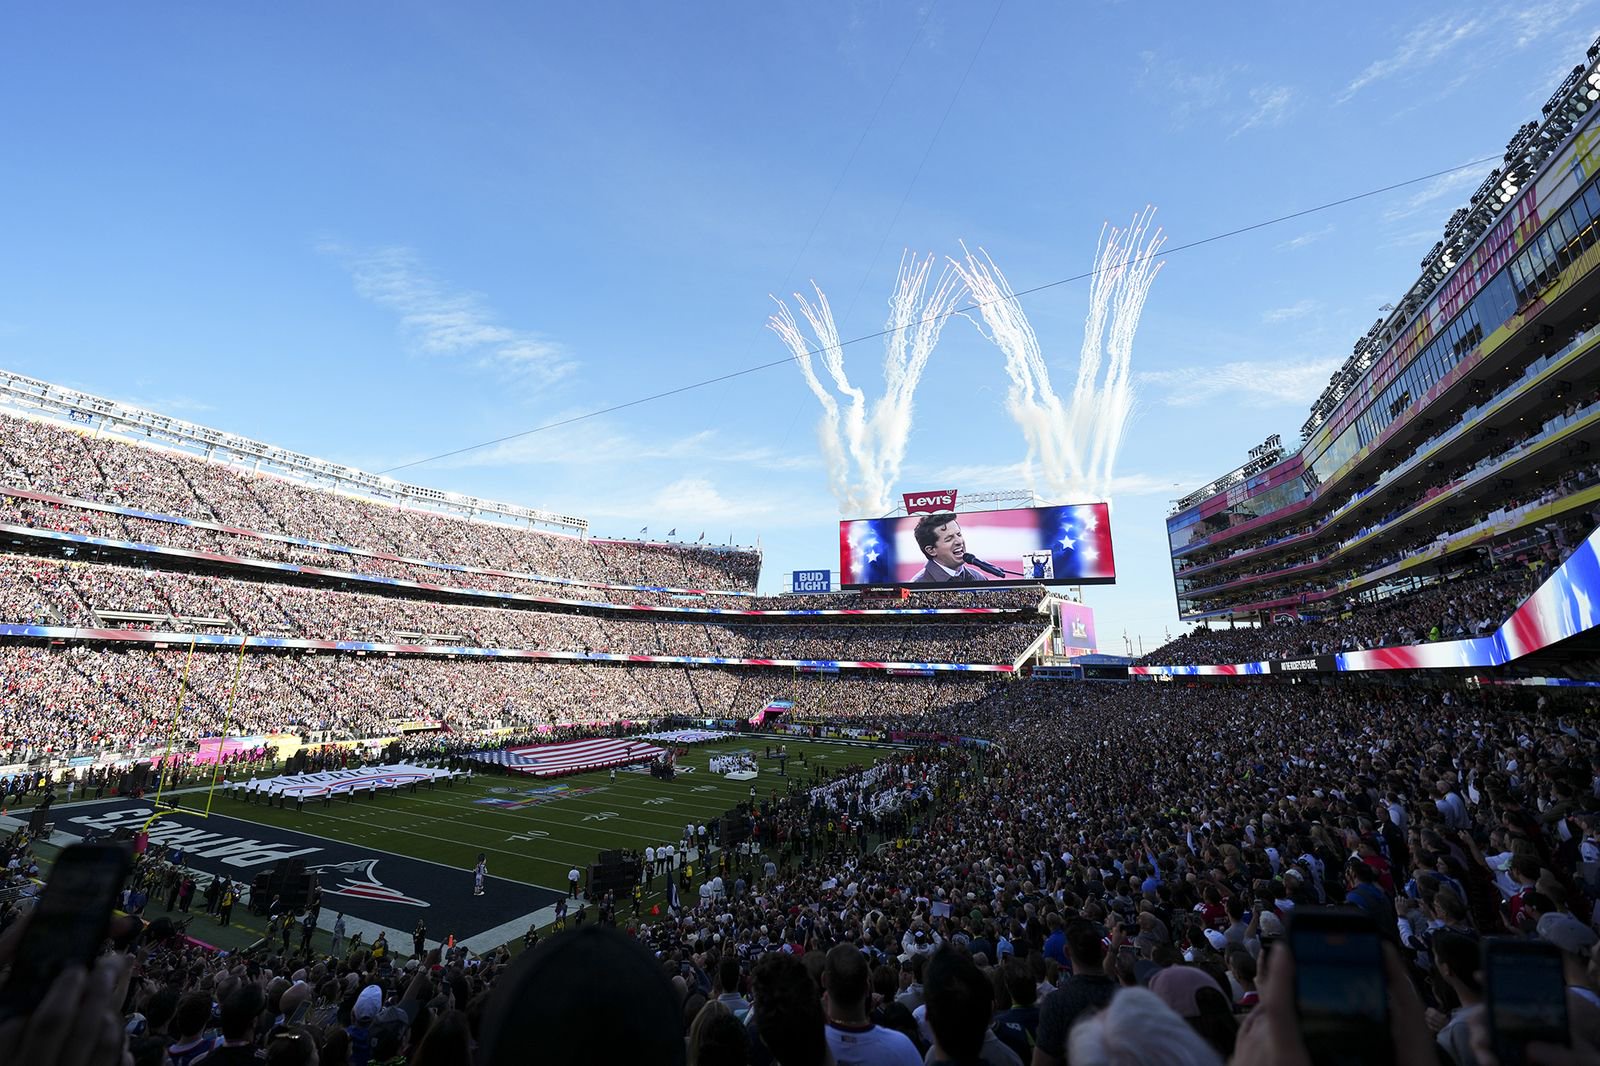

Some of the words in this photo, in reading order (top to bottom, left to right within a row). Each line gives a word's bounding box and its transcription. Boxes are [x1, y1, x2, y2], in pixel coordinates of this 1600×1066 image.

[1438, 259, 1477, 324] SUPER
[1477, 213, 1519, 286] BOWL
[1518, 184, 1542, 241] LX
[799, 572, 824, 582] BUD
[794, 581, 829, 591] LIGHT
[270, 766, 394, 789] AMERICA
[582, 810, 621, 822] 20
[67, 807, 326, 868] PATRIOTS
[504, 830, 551, 842] 10
